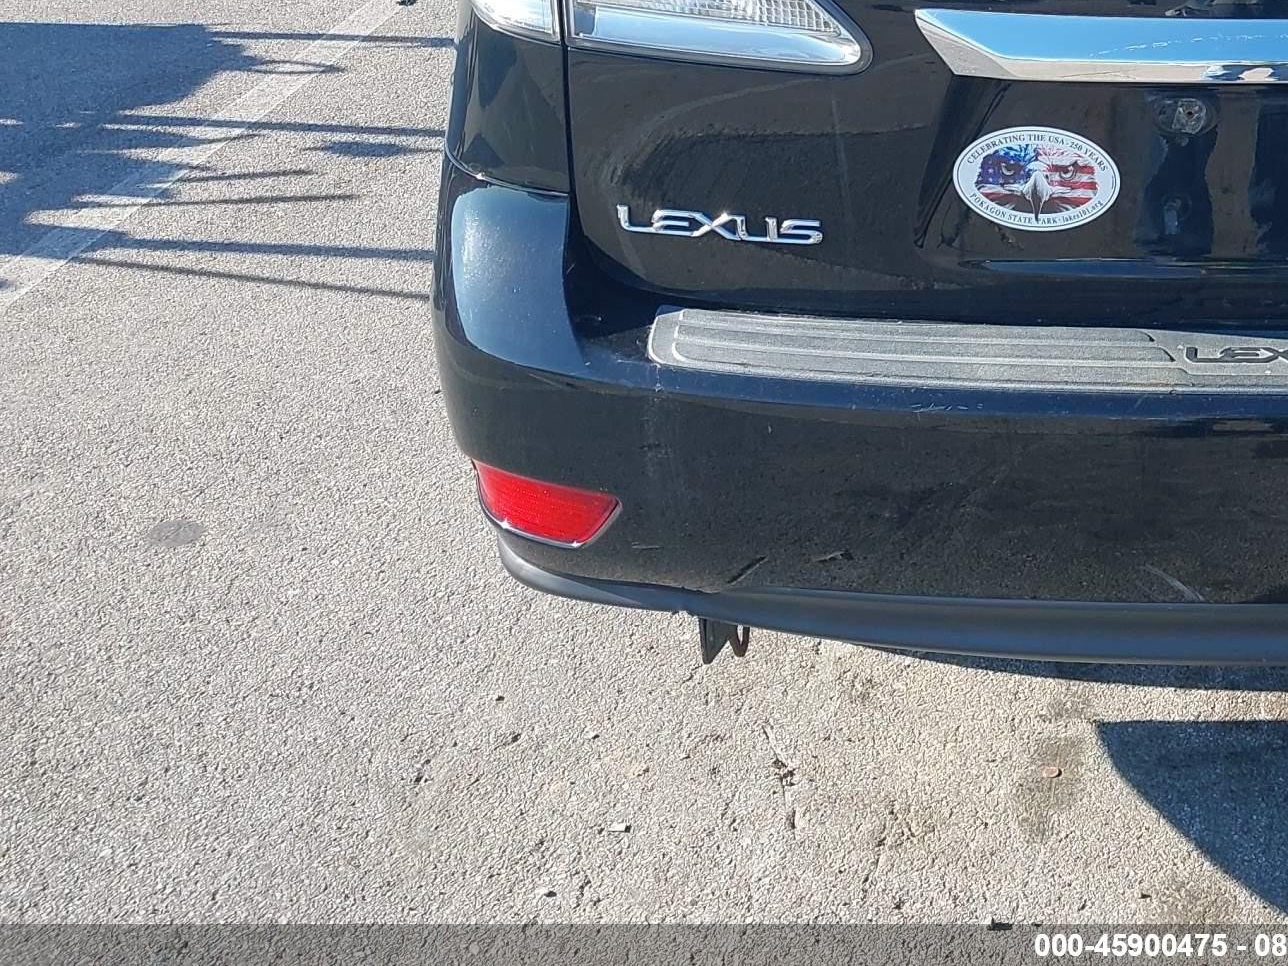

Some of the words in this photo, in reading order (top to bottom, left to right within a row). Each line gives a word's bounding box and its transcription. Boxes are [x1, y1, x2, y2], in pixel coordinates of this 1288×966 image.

[966, 134, 1026, 165] CELEBRATING
[1027, 133, 1047, 143] THE
[1048, 135, 1066, 146] USA
[1070, 141, 1085, 153] 250
[1085, 148, 1109, 172] YEARS
[616, 203, 824, 245] LEXUS
[969, 193, 1007, 220] POKAGON
[1007, 213, 1033, 225] STATE
